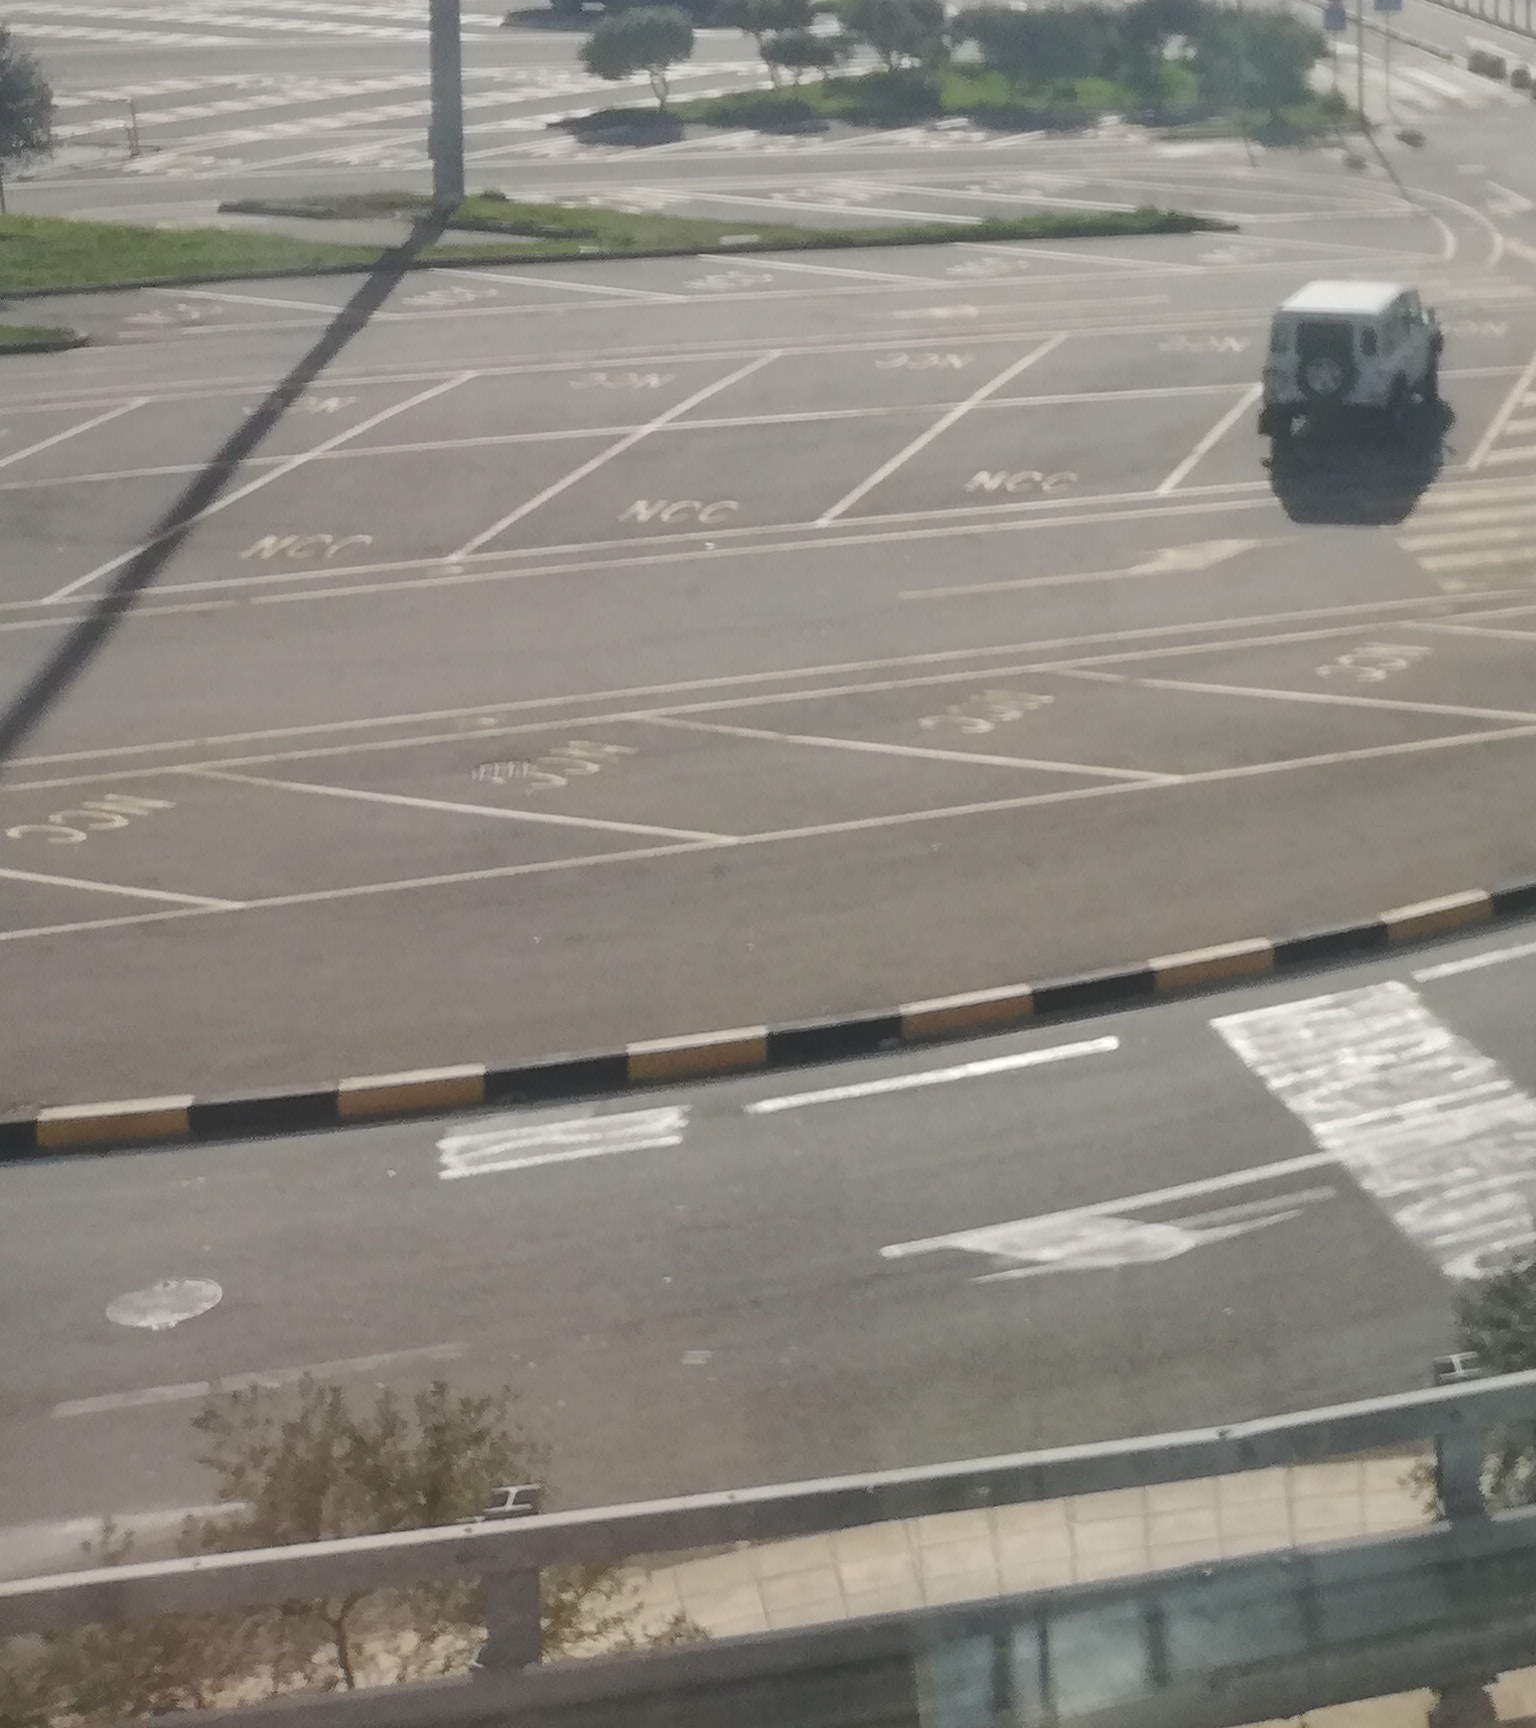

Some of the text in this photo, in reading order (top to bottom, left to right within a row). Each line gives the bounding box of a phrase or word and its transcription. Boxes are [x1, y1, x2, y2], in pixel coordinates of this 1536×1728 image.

[963, 470, 1079, 494] NCC
[617, 498, 740, 524] NCC
[240, 532, 373, 560] NCC
[6, 792, 177, 844] NCC
